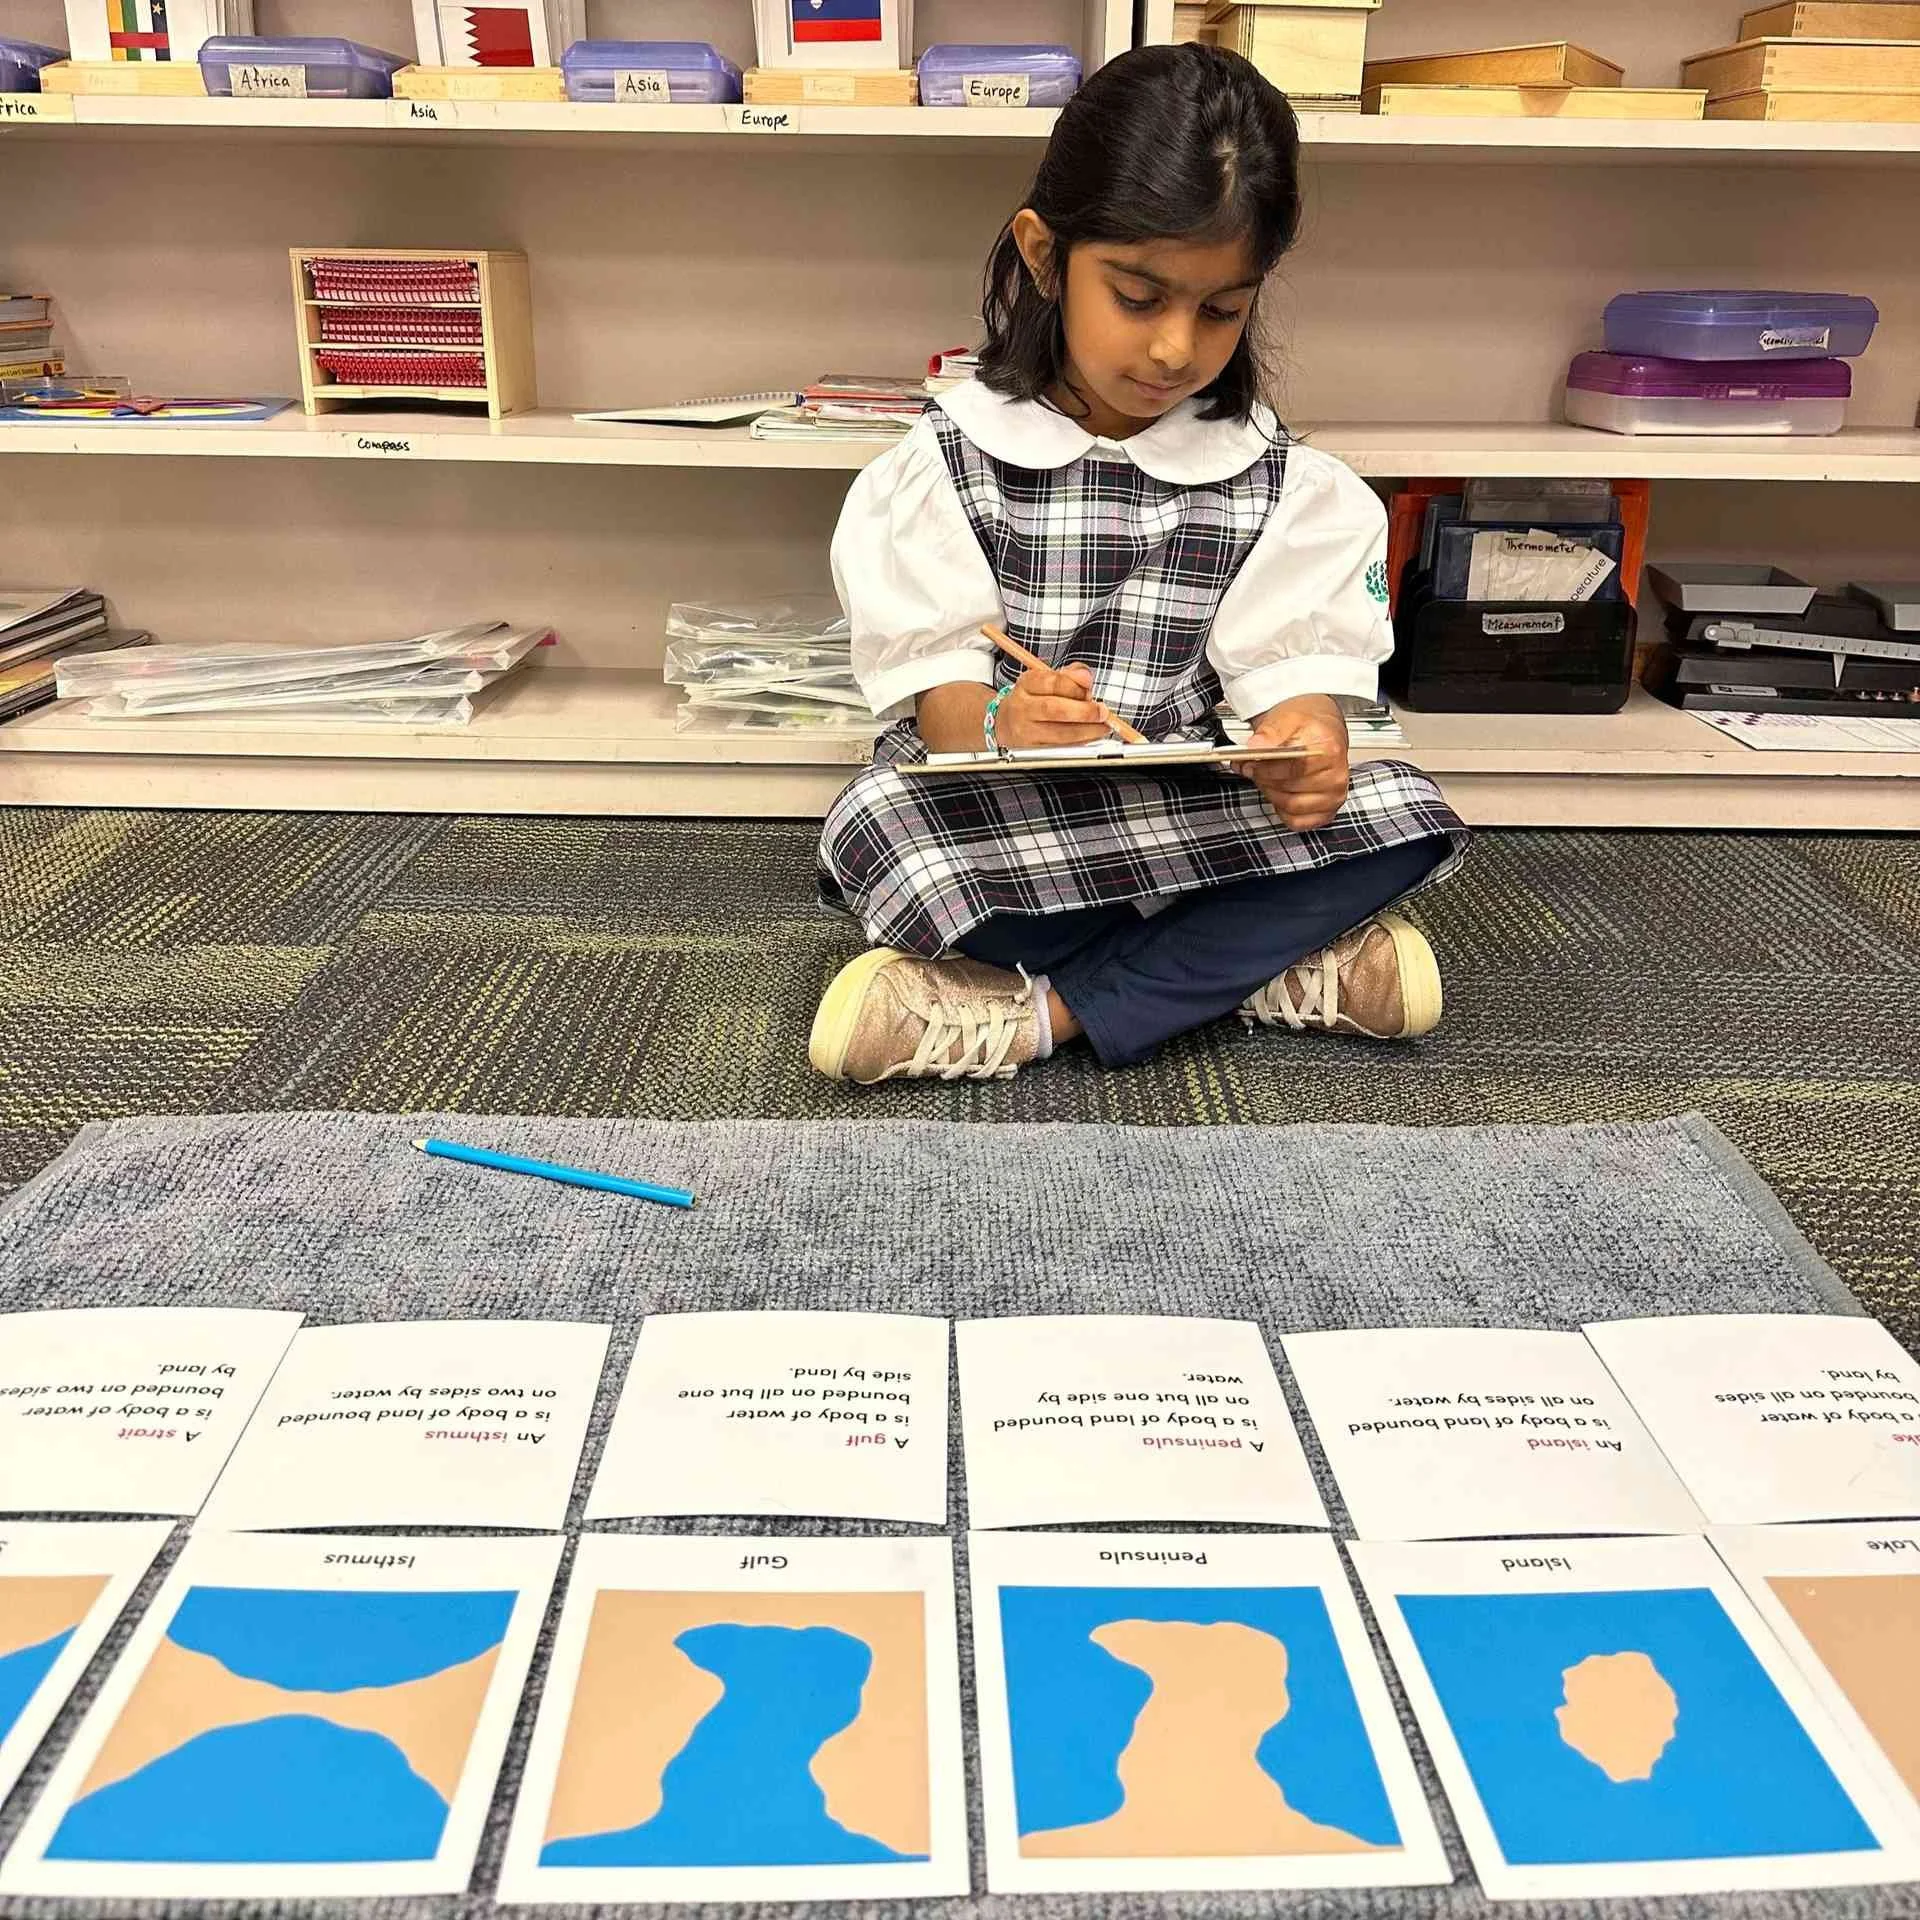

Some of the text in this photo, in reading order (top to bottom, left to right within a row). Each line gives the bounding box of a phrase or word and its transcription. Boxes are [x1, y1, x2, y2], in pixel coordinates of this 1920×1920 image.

[240, 67, 291, 90] Africa
[624, 74, 661, 93] Asia
[970, 79, 1022, 100] Europe
[410, 103, 438, 121] Asia
[741, 109, 789, 128] Europe
[357, 437, 410, 454] Compass
[1504, 537, 1577, 554] Thermometer
[1487, 616, 1561, 630] Measurement
[158, 1363, 237, 1378] by land.
[789, 1366, 912, 1384] side by land.
[1820, 1368, 1901, 1384] by land.
[1182, 1373, 1244, 1385] water.
[56, 1384, 95, 1395] two
[100, 1384, 127, 1393] on
[130, 1384, 225, 1400] bounded
[331, 1385, 557, 1400] on two sides by water.
[677, 1388, 910, 1406] bounded on all but one
[1037, 1391, 1250, 1407] on all but one side by
[1388, 1392, 1595, 1408] on all sides by water.
[1714, 1390, 1920, 1405] bounded on all sides
[22, 1403, 213, 1421] is a body of water
[276, 1405, 551, 1428] is a body of land bounded
[725, 1407, 909, 1427] is a body of water
[1760, 1412, 1819, 1424] water
[1822, 1411, 1843, 1424] of
[1847, 1408, 1900, 1424] body
[1899, 1412, 1915, 1422] a
[993, 1411, 1259, 1433] is a body of land bounded
[1347, 1413, 1612, 1437] is a body of land bounded
[117, 1427, 202, 1443] A strait
[424, 1430, 546, 1445] An isthmus
[845, 1432, 910, 1449] A gulf
[1142, 1437, 1265, 1453] A peninsula
[1526, 1438, 1622, 1453] An island
[1866, 1539, 1920, 1554] Lake
[323, 1553, 416, 1569] Isthmus
[739, 1555, 789, 1570] Gulf
[1099, 1551, 1208, 1565] Peninsula
[1500, 1557, 1573, 1573] Island
